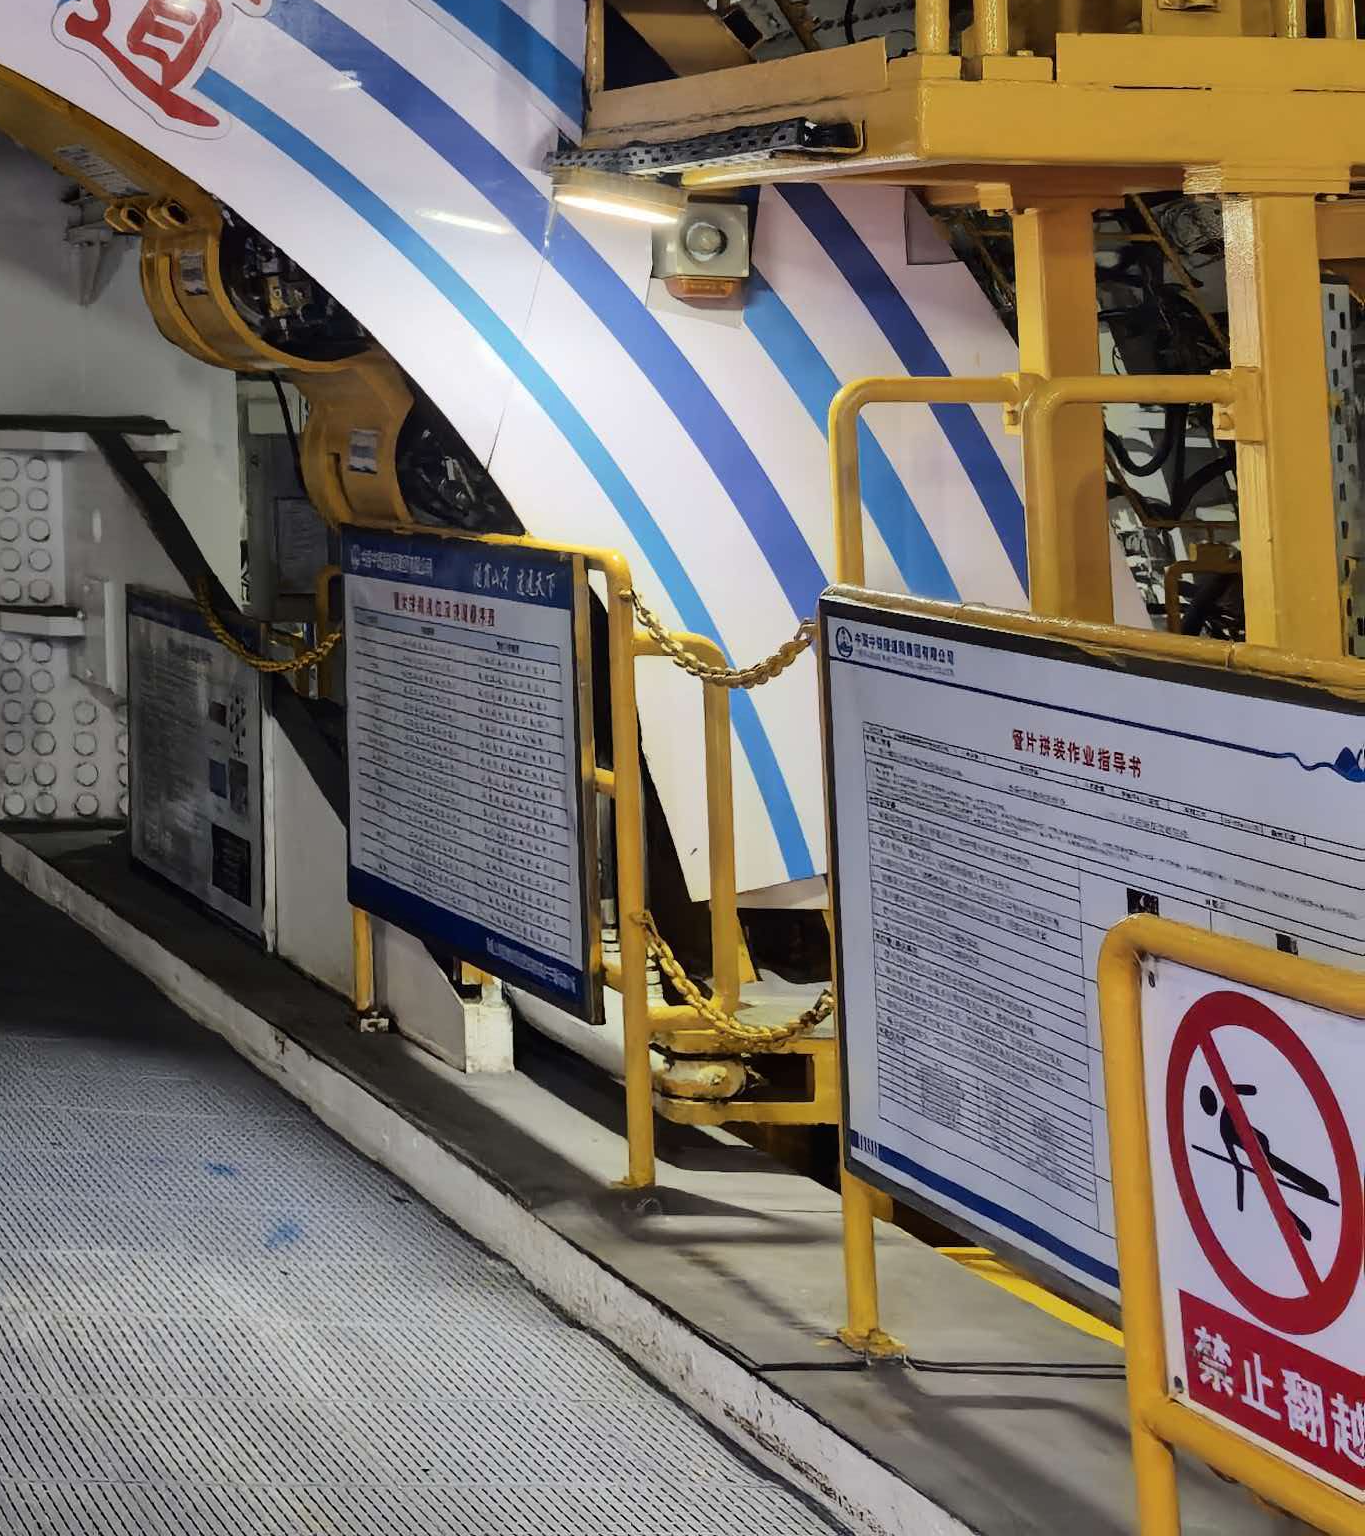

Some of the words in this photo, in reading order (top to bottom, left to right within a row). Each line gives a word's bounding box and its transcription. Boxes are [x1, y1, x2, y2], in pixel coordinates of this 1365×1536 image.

[1012, 729, 1142, 779] 管片拼装作业指导书
[1193, 1326, 1365, 1469] 禁止翻越
